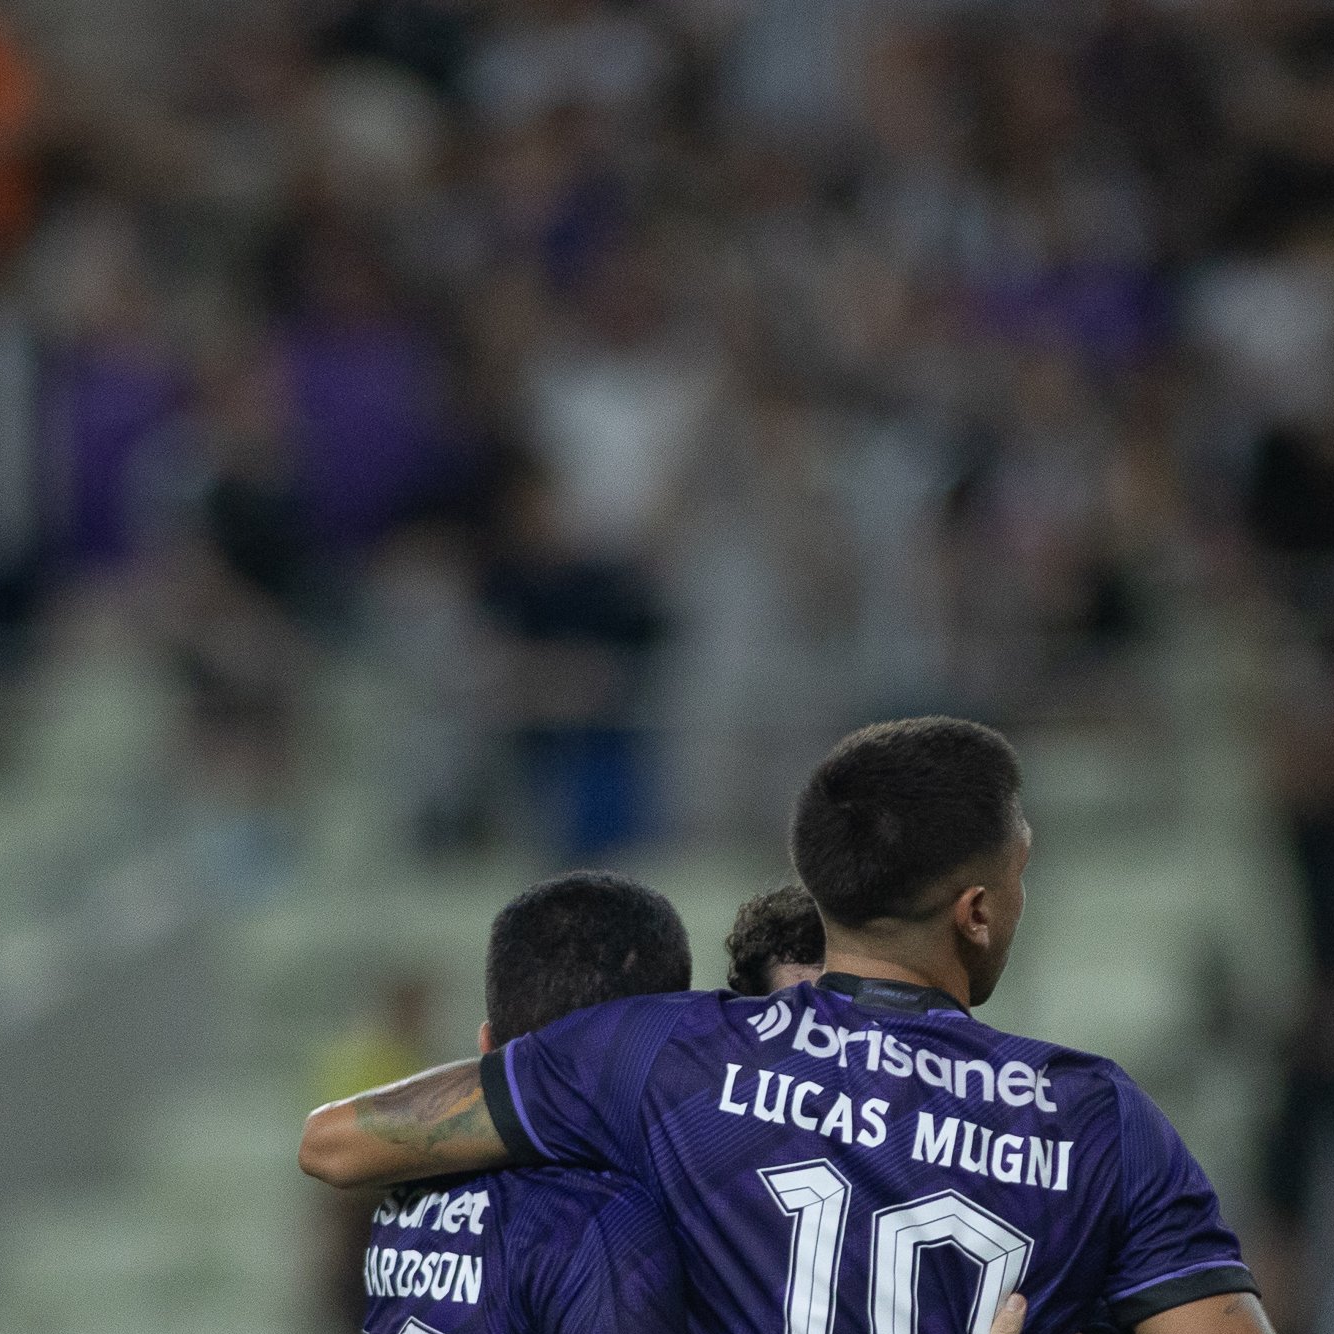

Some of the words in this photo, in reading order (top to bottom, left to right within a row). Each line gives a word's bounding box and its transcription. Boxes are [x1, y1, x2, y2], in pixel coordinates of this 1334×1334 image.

[792, 1006, 1057, 1112] brisanet
[718, 1062, 890, 1148] LUCAS
[911, 1111, 1074, 1191] MUGNI
